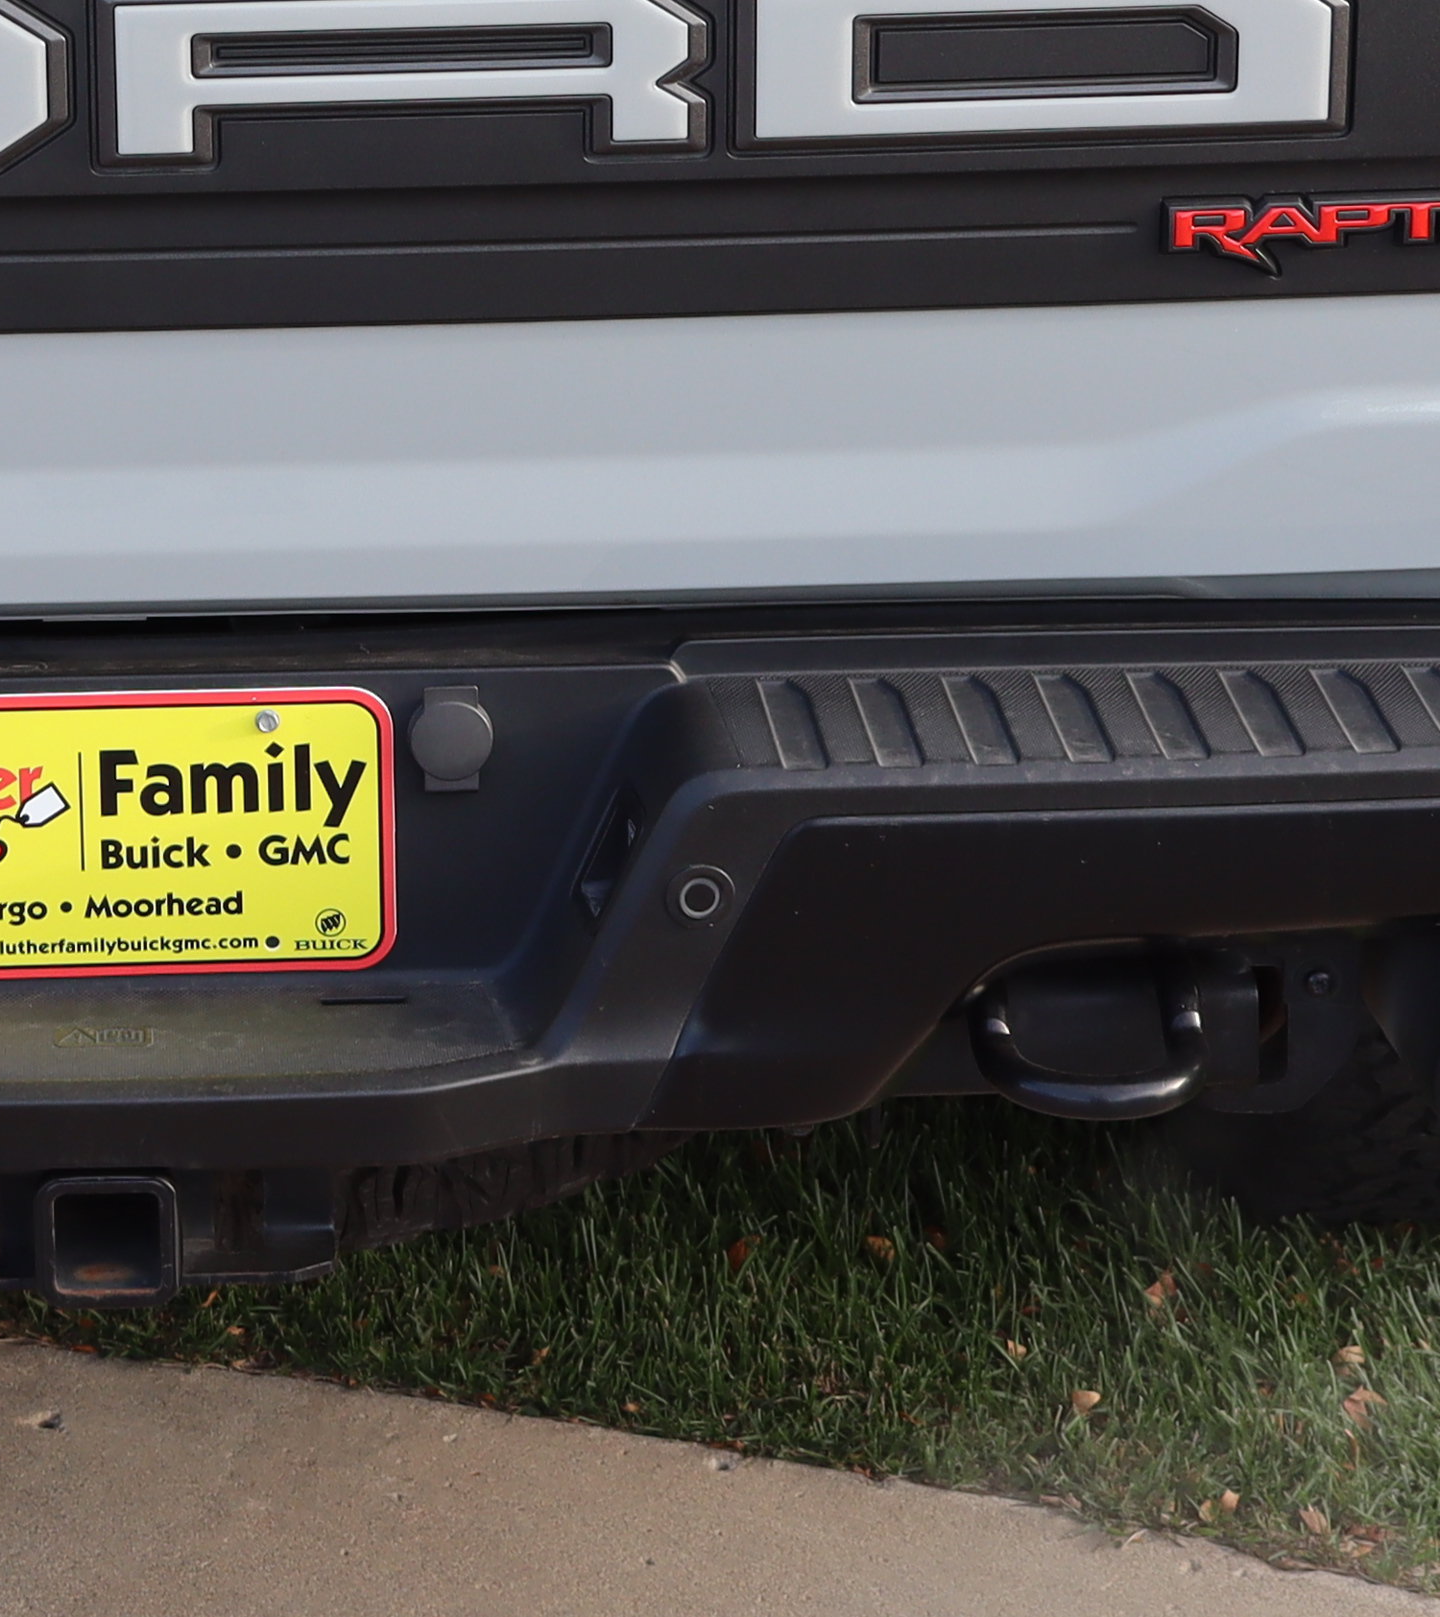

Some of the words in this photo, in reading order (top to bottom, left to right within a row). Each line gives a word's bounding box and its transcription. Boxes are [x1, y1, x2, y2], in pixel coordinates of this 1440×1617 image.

[98, 742, 368, 827] Family
[101, 837, 210, 870] Buick
[258, 833, 351, 866] GMC
[84, 891, 243, 920] Moorhead
[294, 937, 368, 951] BUICK
